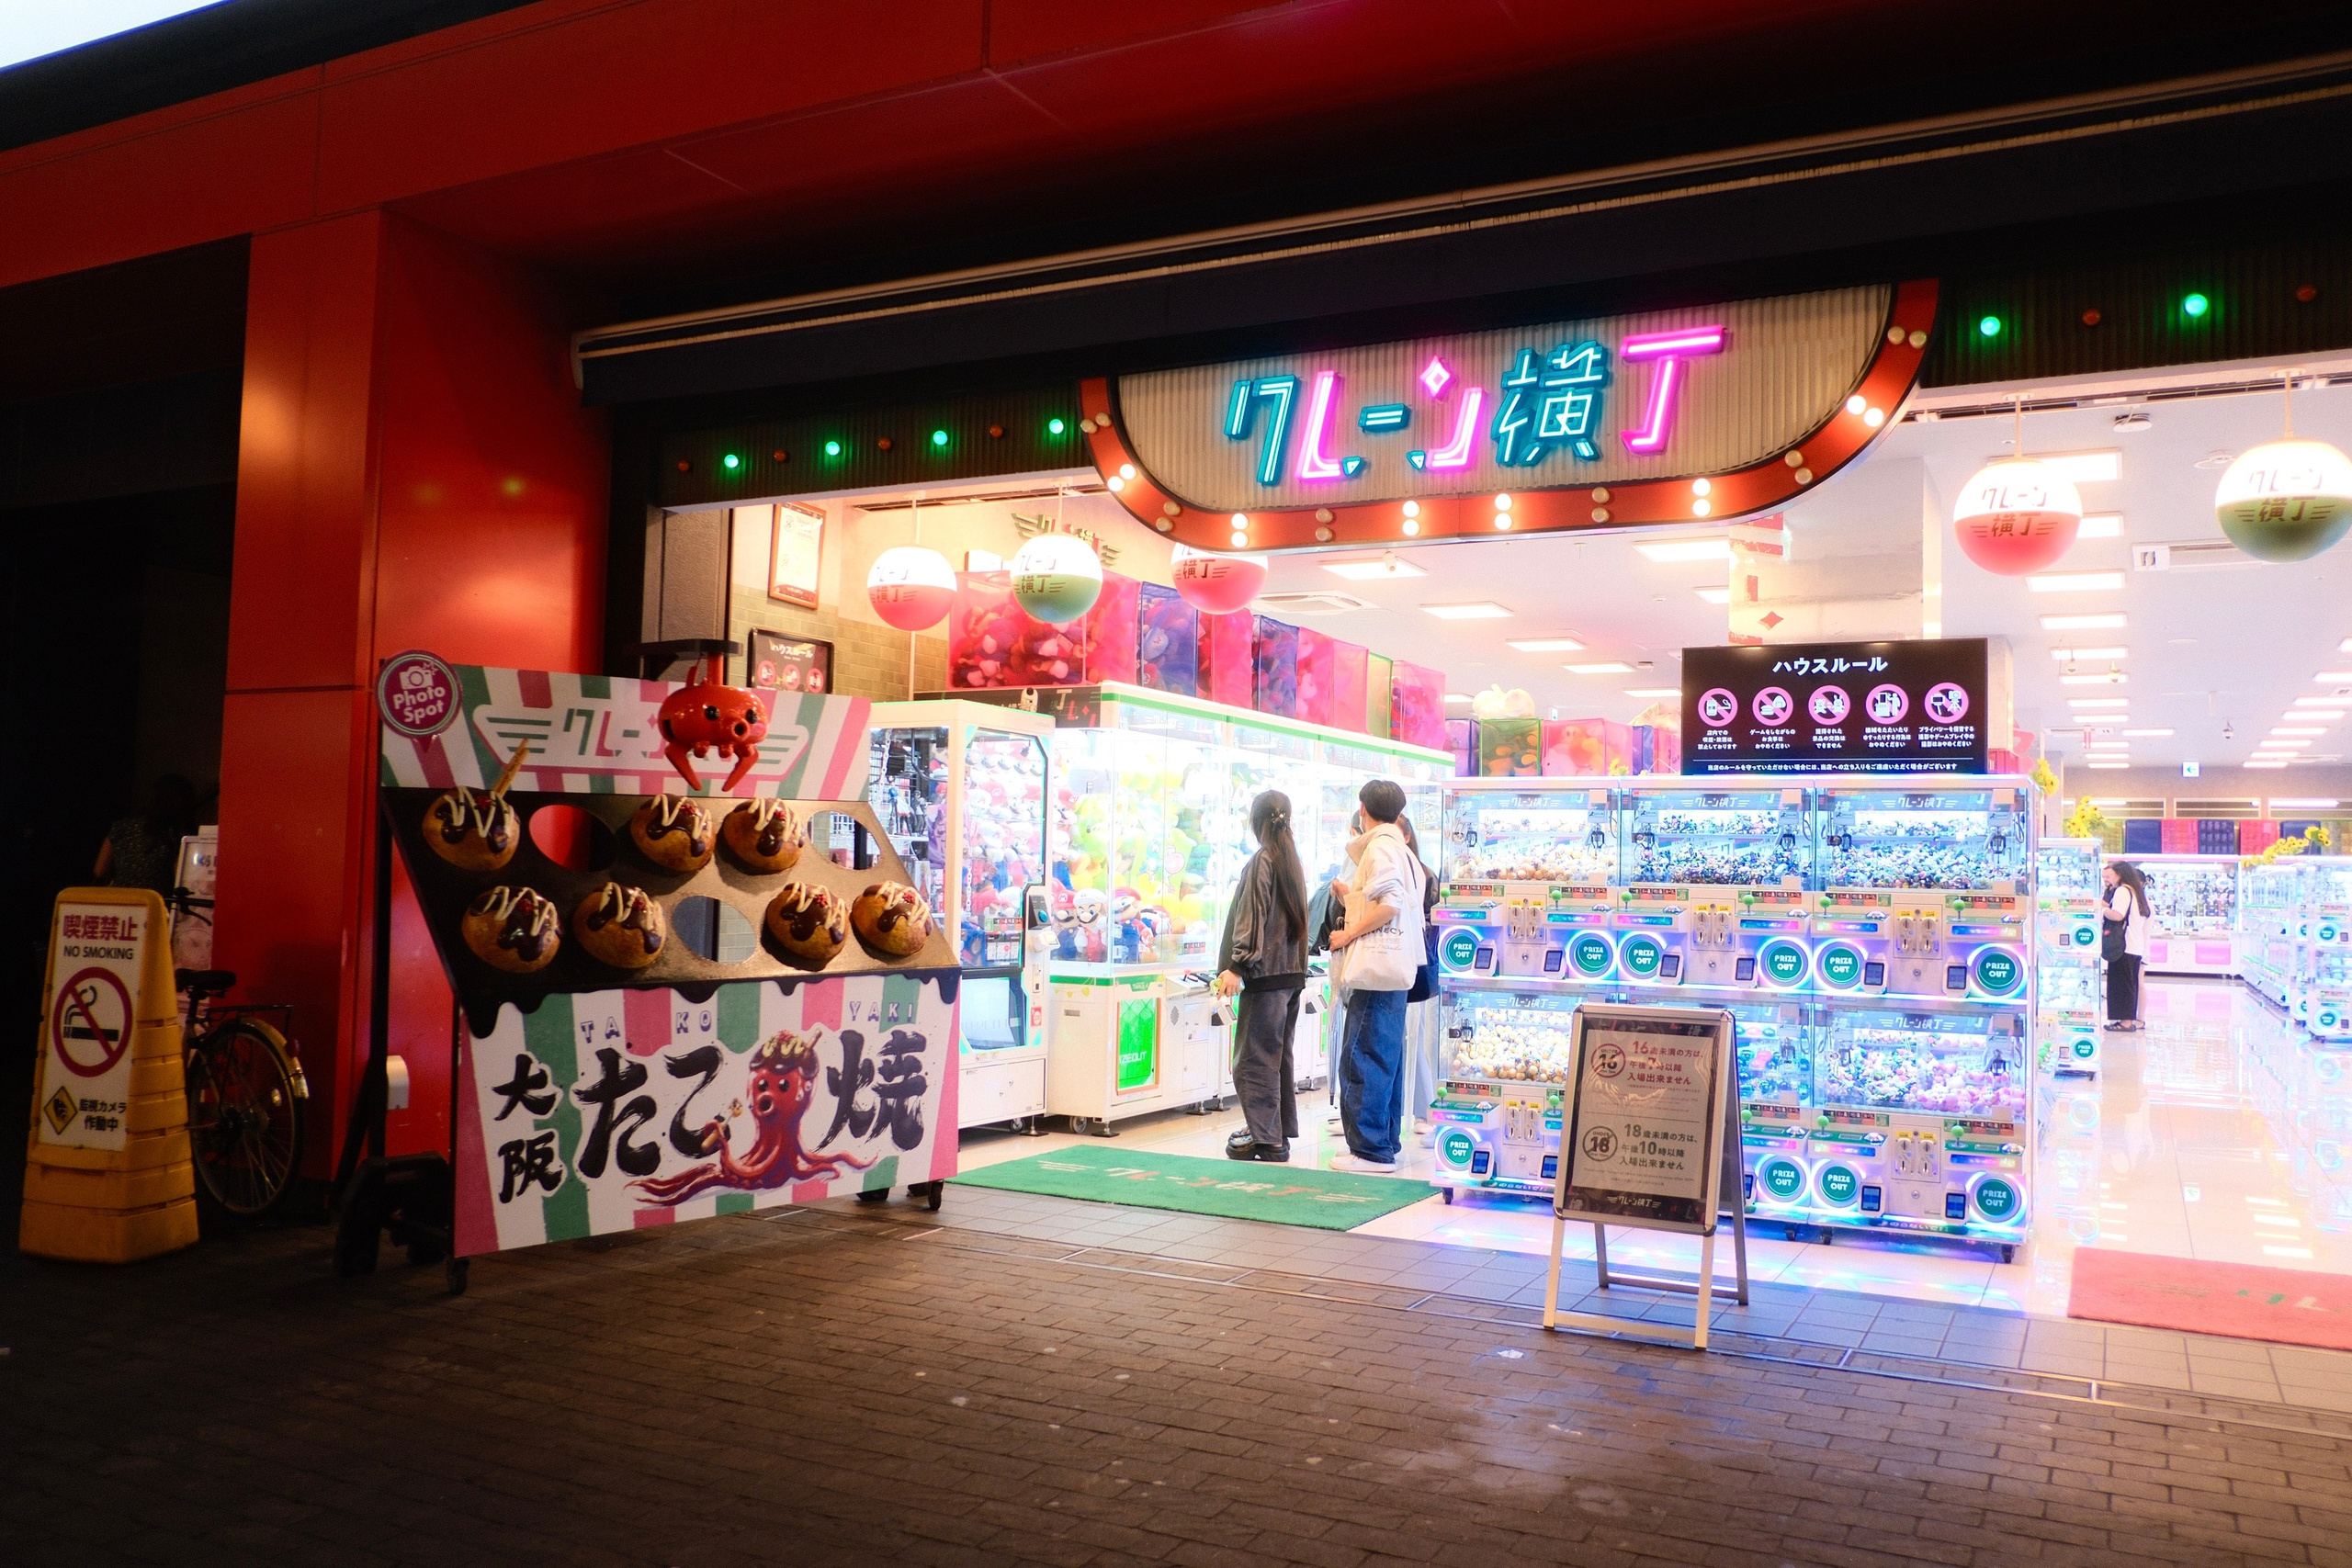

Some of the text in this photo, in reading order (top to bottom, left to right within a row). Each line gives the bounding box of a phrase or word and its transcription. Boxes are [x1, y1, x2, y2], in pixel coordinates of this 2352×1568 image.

[1224, 327, 1730, 485] クレーン横丁
[2259, 496, 2317, 523] 横丁
[1992, 513, 2041, 537] 横丁
[1183, 558, 1216, 580] 横丁
[1022, 575, 1052, 593] 横丁
[1772, 656, 1888, 676] ハウスルール
[392, 682, 446, 710] Photo
[403, 699, 445, 725] Spot
[62, 914, 138, 942] 喫煙禁止
[63, 945, 133, 960] NO SMOKING
[1774, 954, 1796, 963] PRIZE
[1777, 963, 1793, 971] OUT
[1830, 956, 1852, 964] PRIZE
[1985, 962, 2010, 970] PRIZE
[1833, 964, 1850, 973] OUT
[1988, 970, 2007, 978] OUT
[582, 1001, 914, 1043] TA KO YAKI
[1627, 1073, 1691, 1085] 入場出来ません
[79, 1100, 126, 1114] 監視カメラ
[84, 1115, 119, 1131] 作動中
[492, 1053, 563, 1203] 大阪
[1450, 1141, 1468, 1149] PRIZE
[1590, 1136, 1610, 1153] 18
[1622, 1141, 1685, 1157] 午後10時以降
[1620, 1156, 1684, 1170] 入場出来ません
[1773, 1169, 1795, 1178] PRIZE
[1827, 1174, 1850, 1183] PRIZE
[1830, 1182, 1848, 1190] OUT
[1983, 1190, 2007, 1199] PRIZE
[1985, 1199, 2004, 1207] OUT
